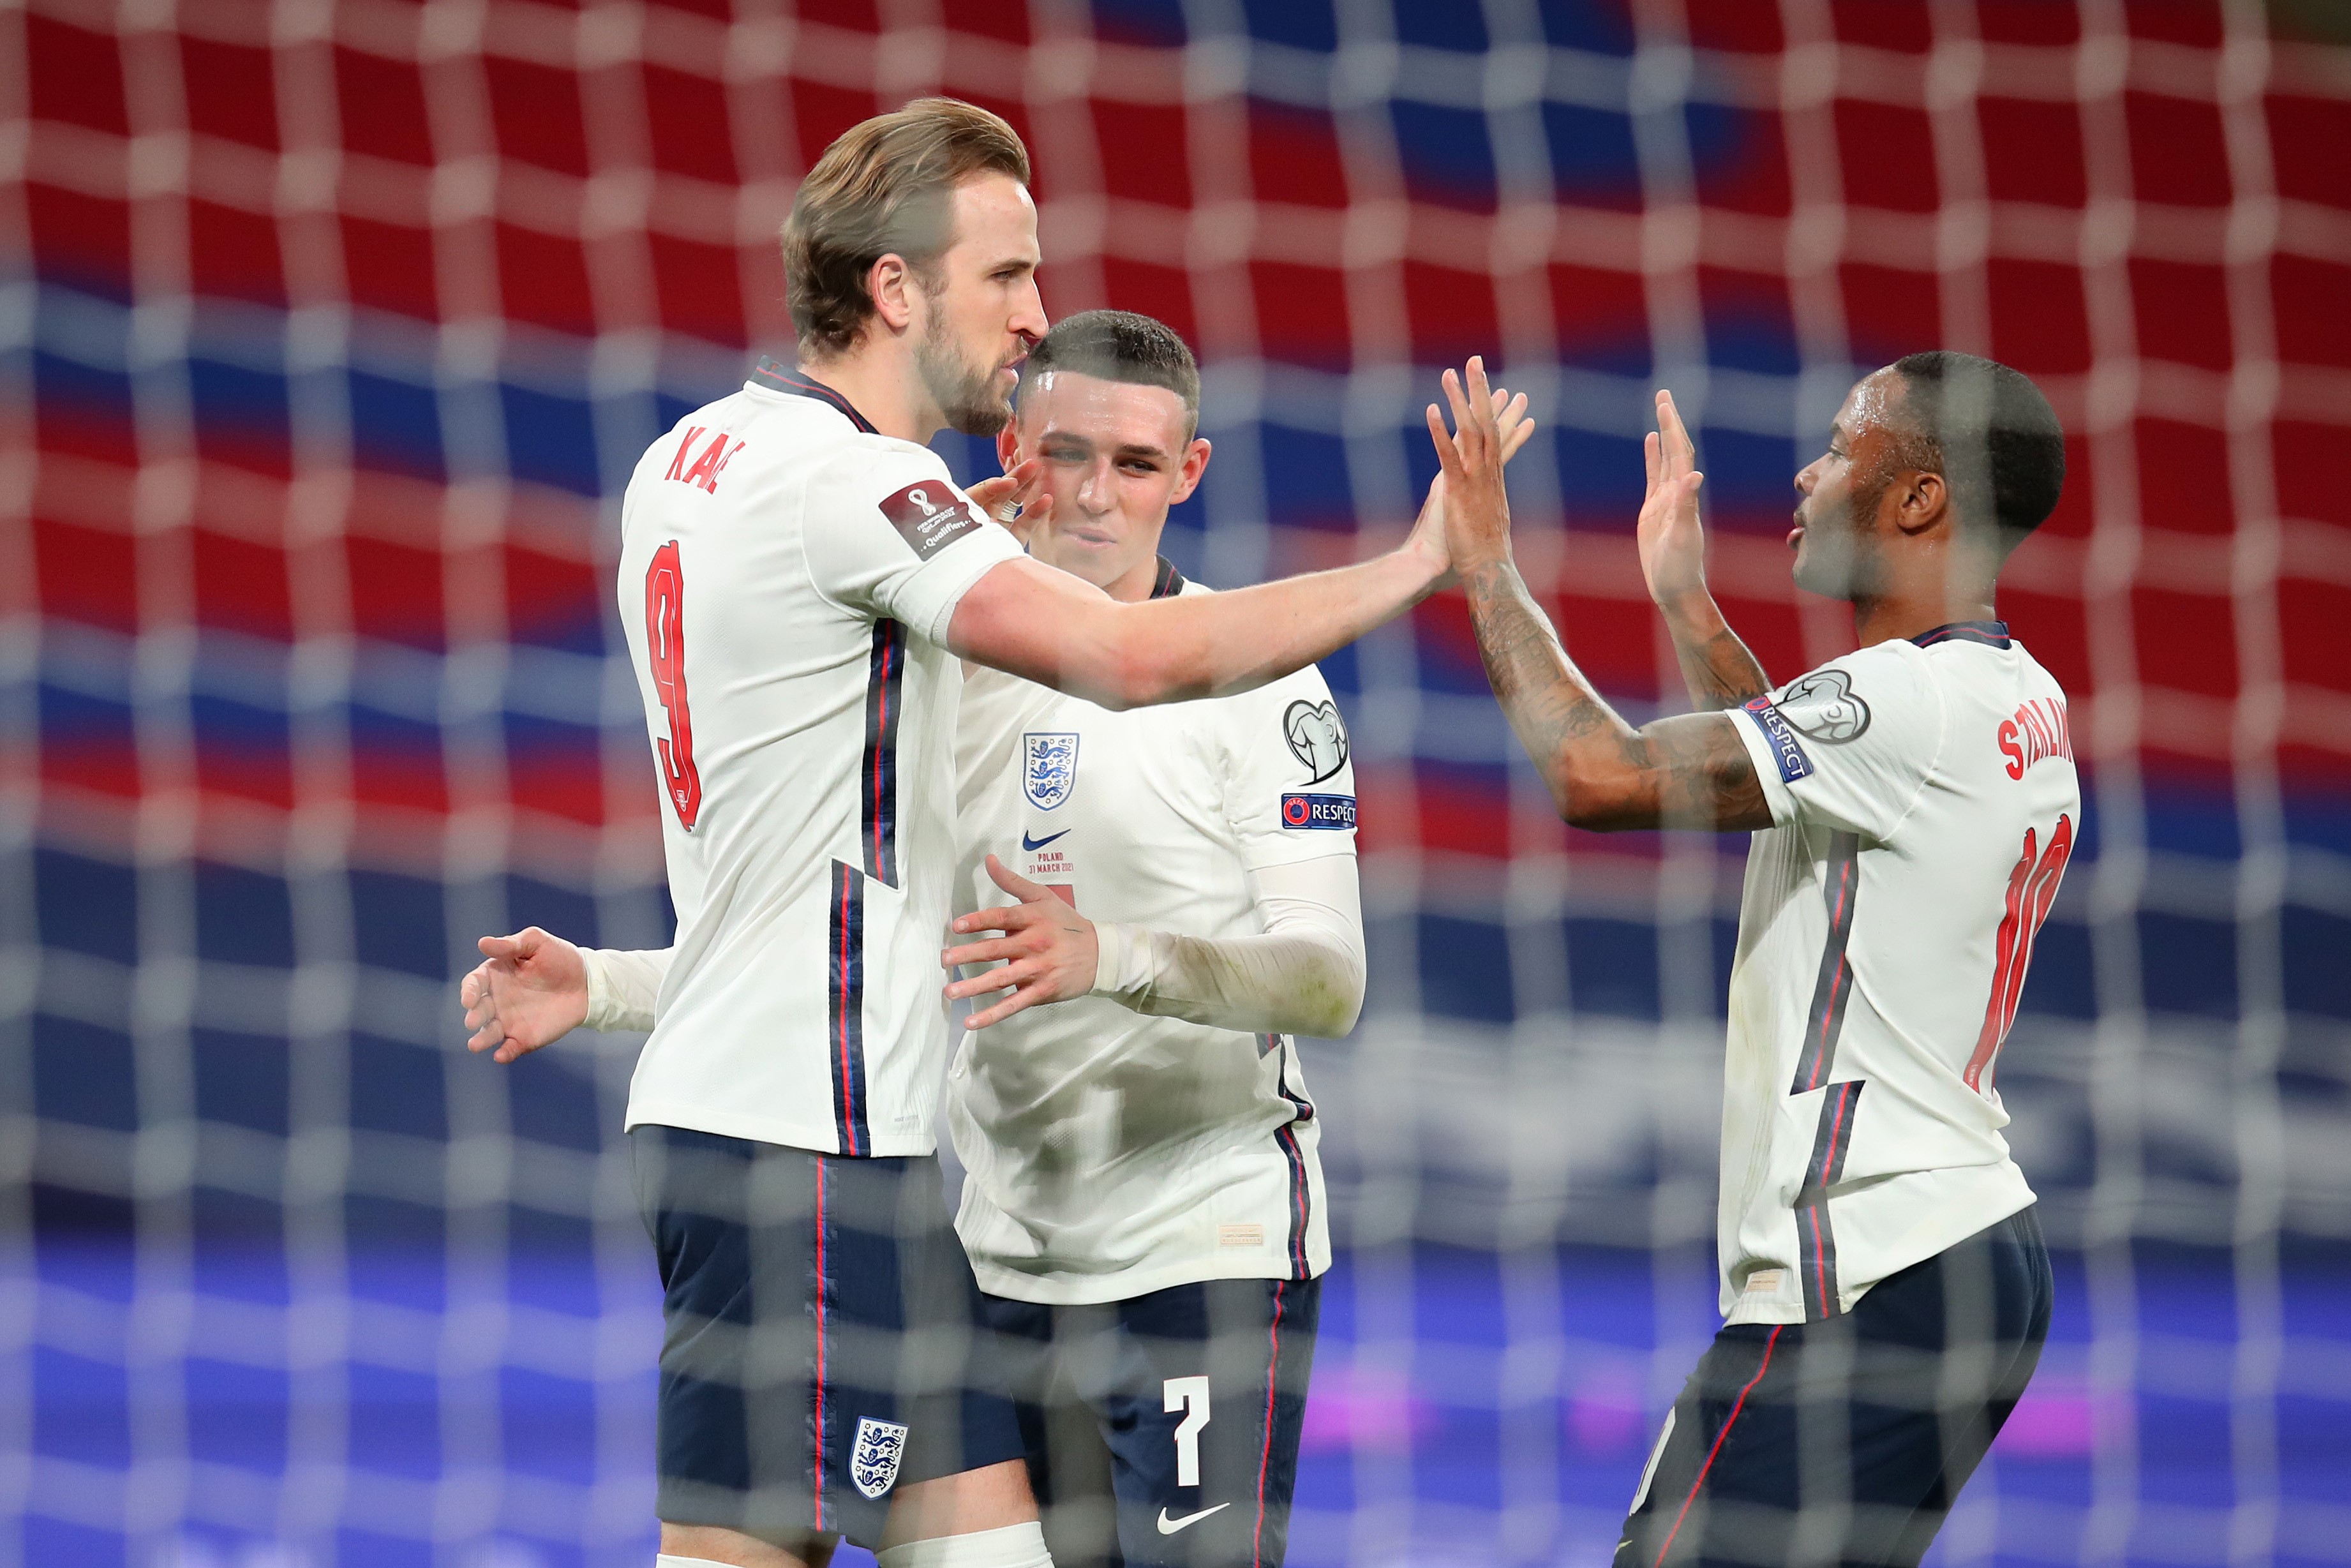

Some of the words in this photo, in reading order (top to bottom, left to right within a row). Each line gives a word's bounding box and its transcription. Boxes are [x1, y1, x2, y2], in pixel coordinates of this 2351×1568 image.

[916, 521, 928, 531] FIFA
[927, 511, 945, 524] WORLD
[944, 506, 954, 514] CUP
[925, 521, 966, 547] Qualifiers
[646, 540, 701, 832] 9
[1759, 706, 1805, 776] RESPECT
[1312, 804, 1355, 822] RESPECT
[1029, 865, 1036, 874] 31
[1037, 863, 1060, 873] MARCH
[1062, 863, 1074, 872] 2021
[1038, 852, 1063, 862] POLAND
[1163, 1375, 1211, 1487] 7
